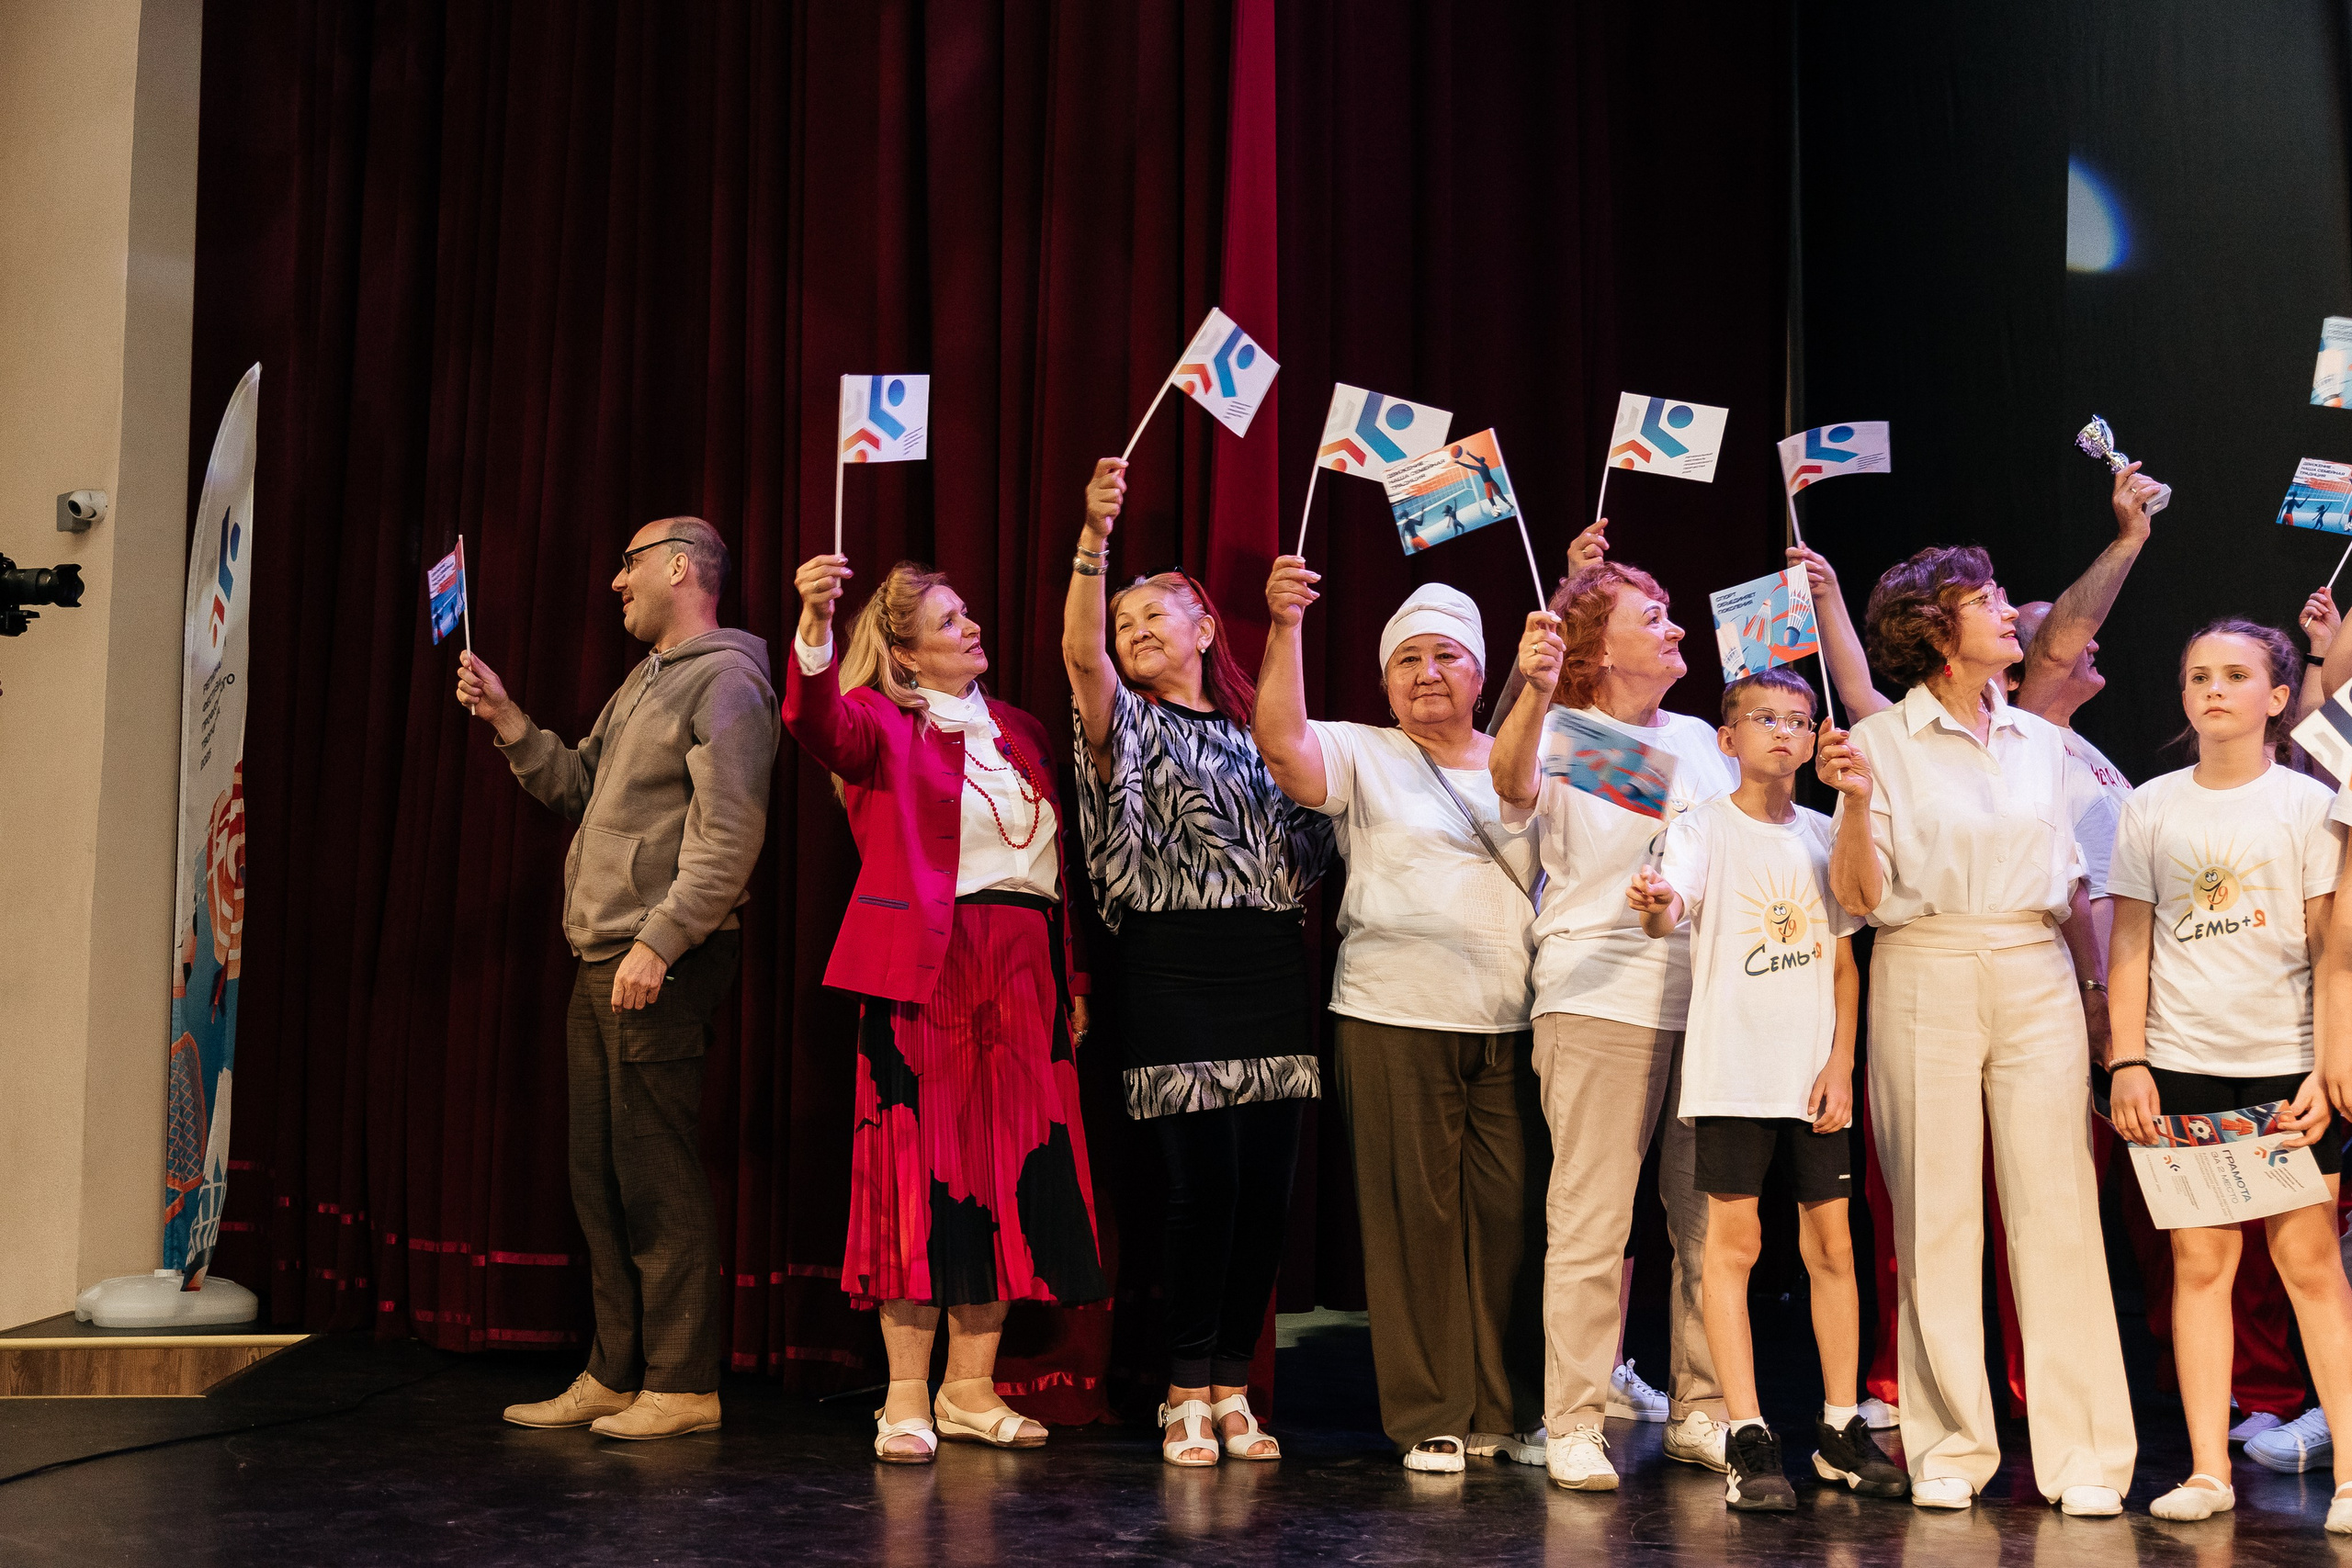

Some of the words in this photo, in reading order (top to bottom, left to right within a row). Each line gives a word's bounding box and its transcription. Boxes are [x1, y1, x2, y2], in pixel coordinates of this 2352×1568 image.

[2211, 1151, 2222, 1164] ЗА
[2221, 1174, 2239, 1204] МЕСТО
[2222, 1149, 2252, 1202] ГРАМОТА
